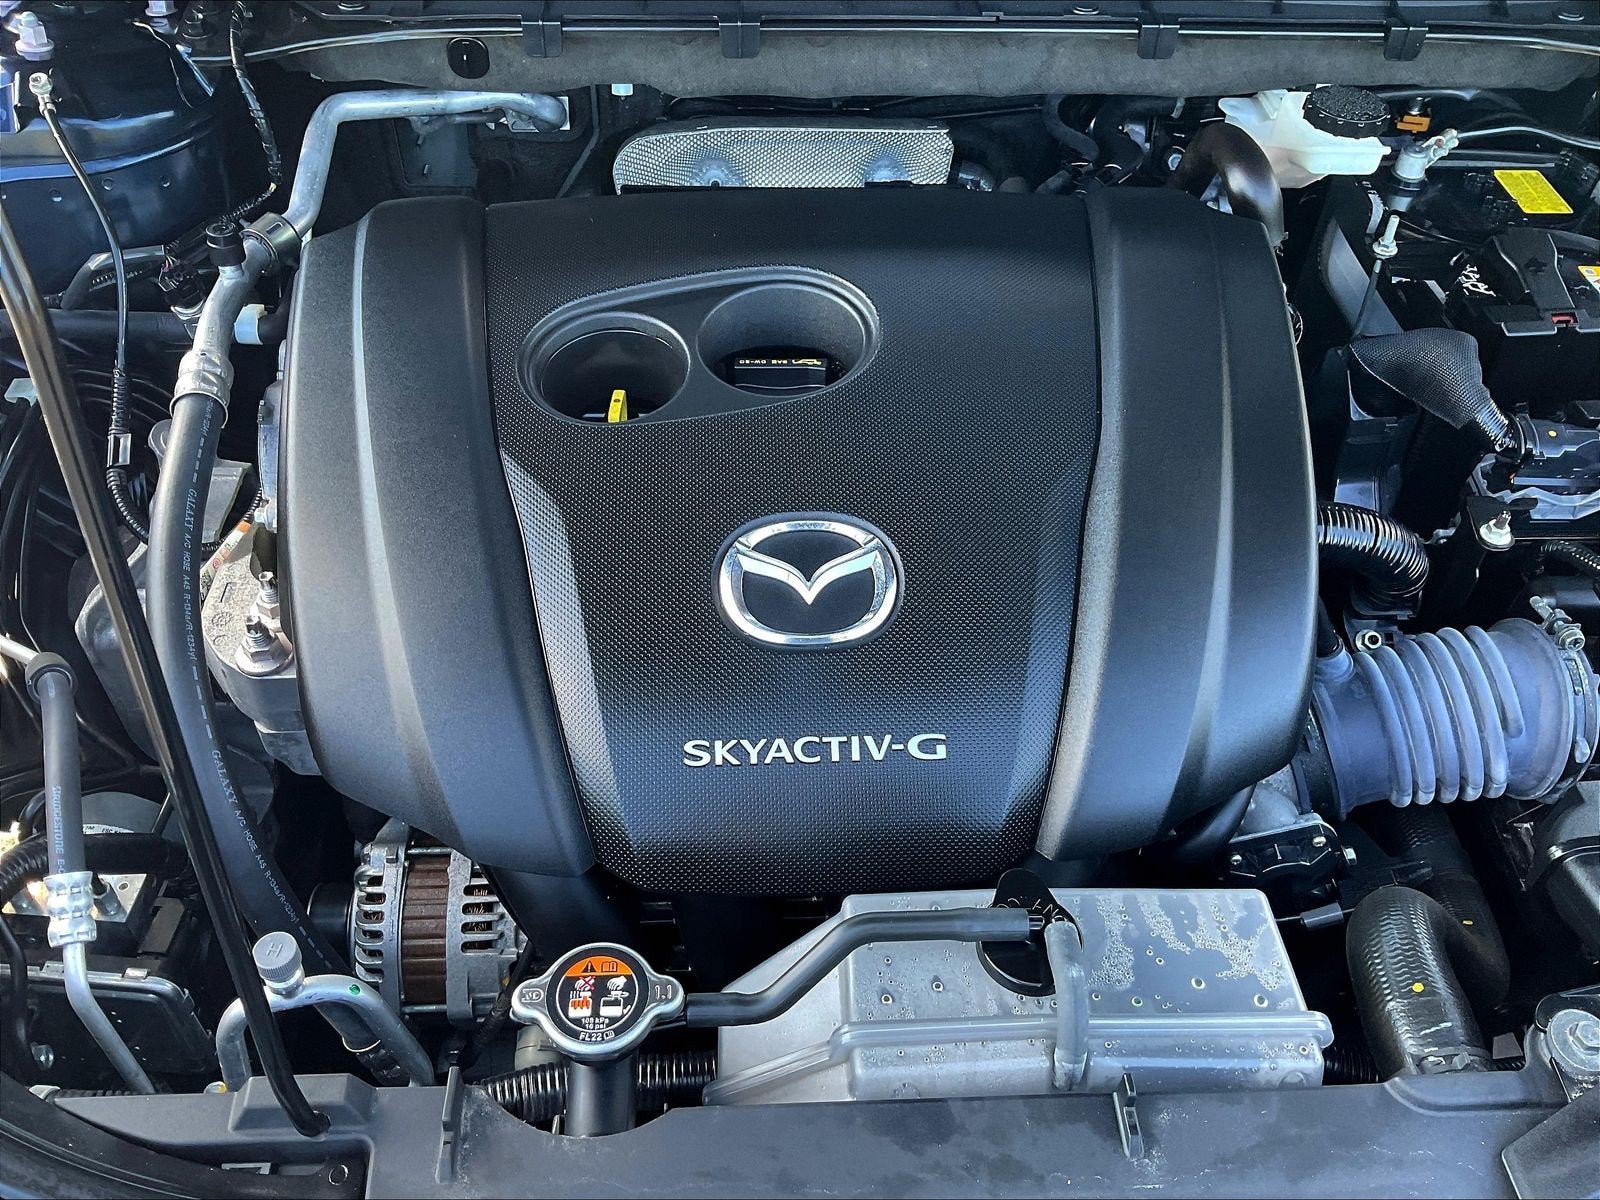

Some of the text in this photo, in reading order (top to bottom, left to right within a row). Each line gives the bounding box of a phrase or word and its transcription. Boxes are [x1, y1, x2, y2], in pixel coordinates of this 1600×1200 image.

[184, 488, 198, 531] GALAXY
[184, 533, 192, 549] A/C
[182, 550, 192, 572] HOSE
[683, 733, 948, 767] SKYACTIV-G
[211, 749, 239, 803] GALAXY
[234, 809, 247, 827] A/C
[243, 828, 259, 852] HOSE
[52, 785, 65, 854] BRIDGESTONE
[266, 942, 284, 958] H
[654, 984, 673, 1000] 1.1
[579, 1031, 603, 1041] FL22
